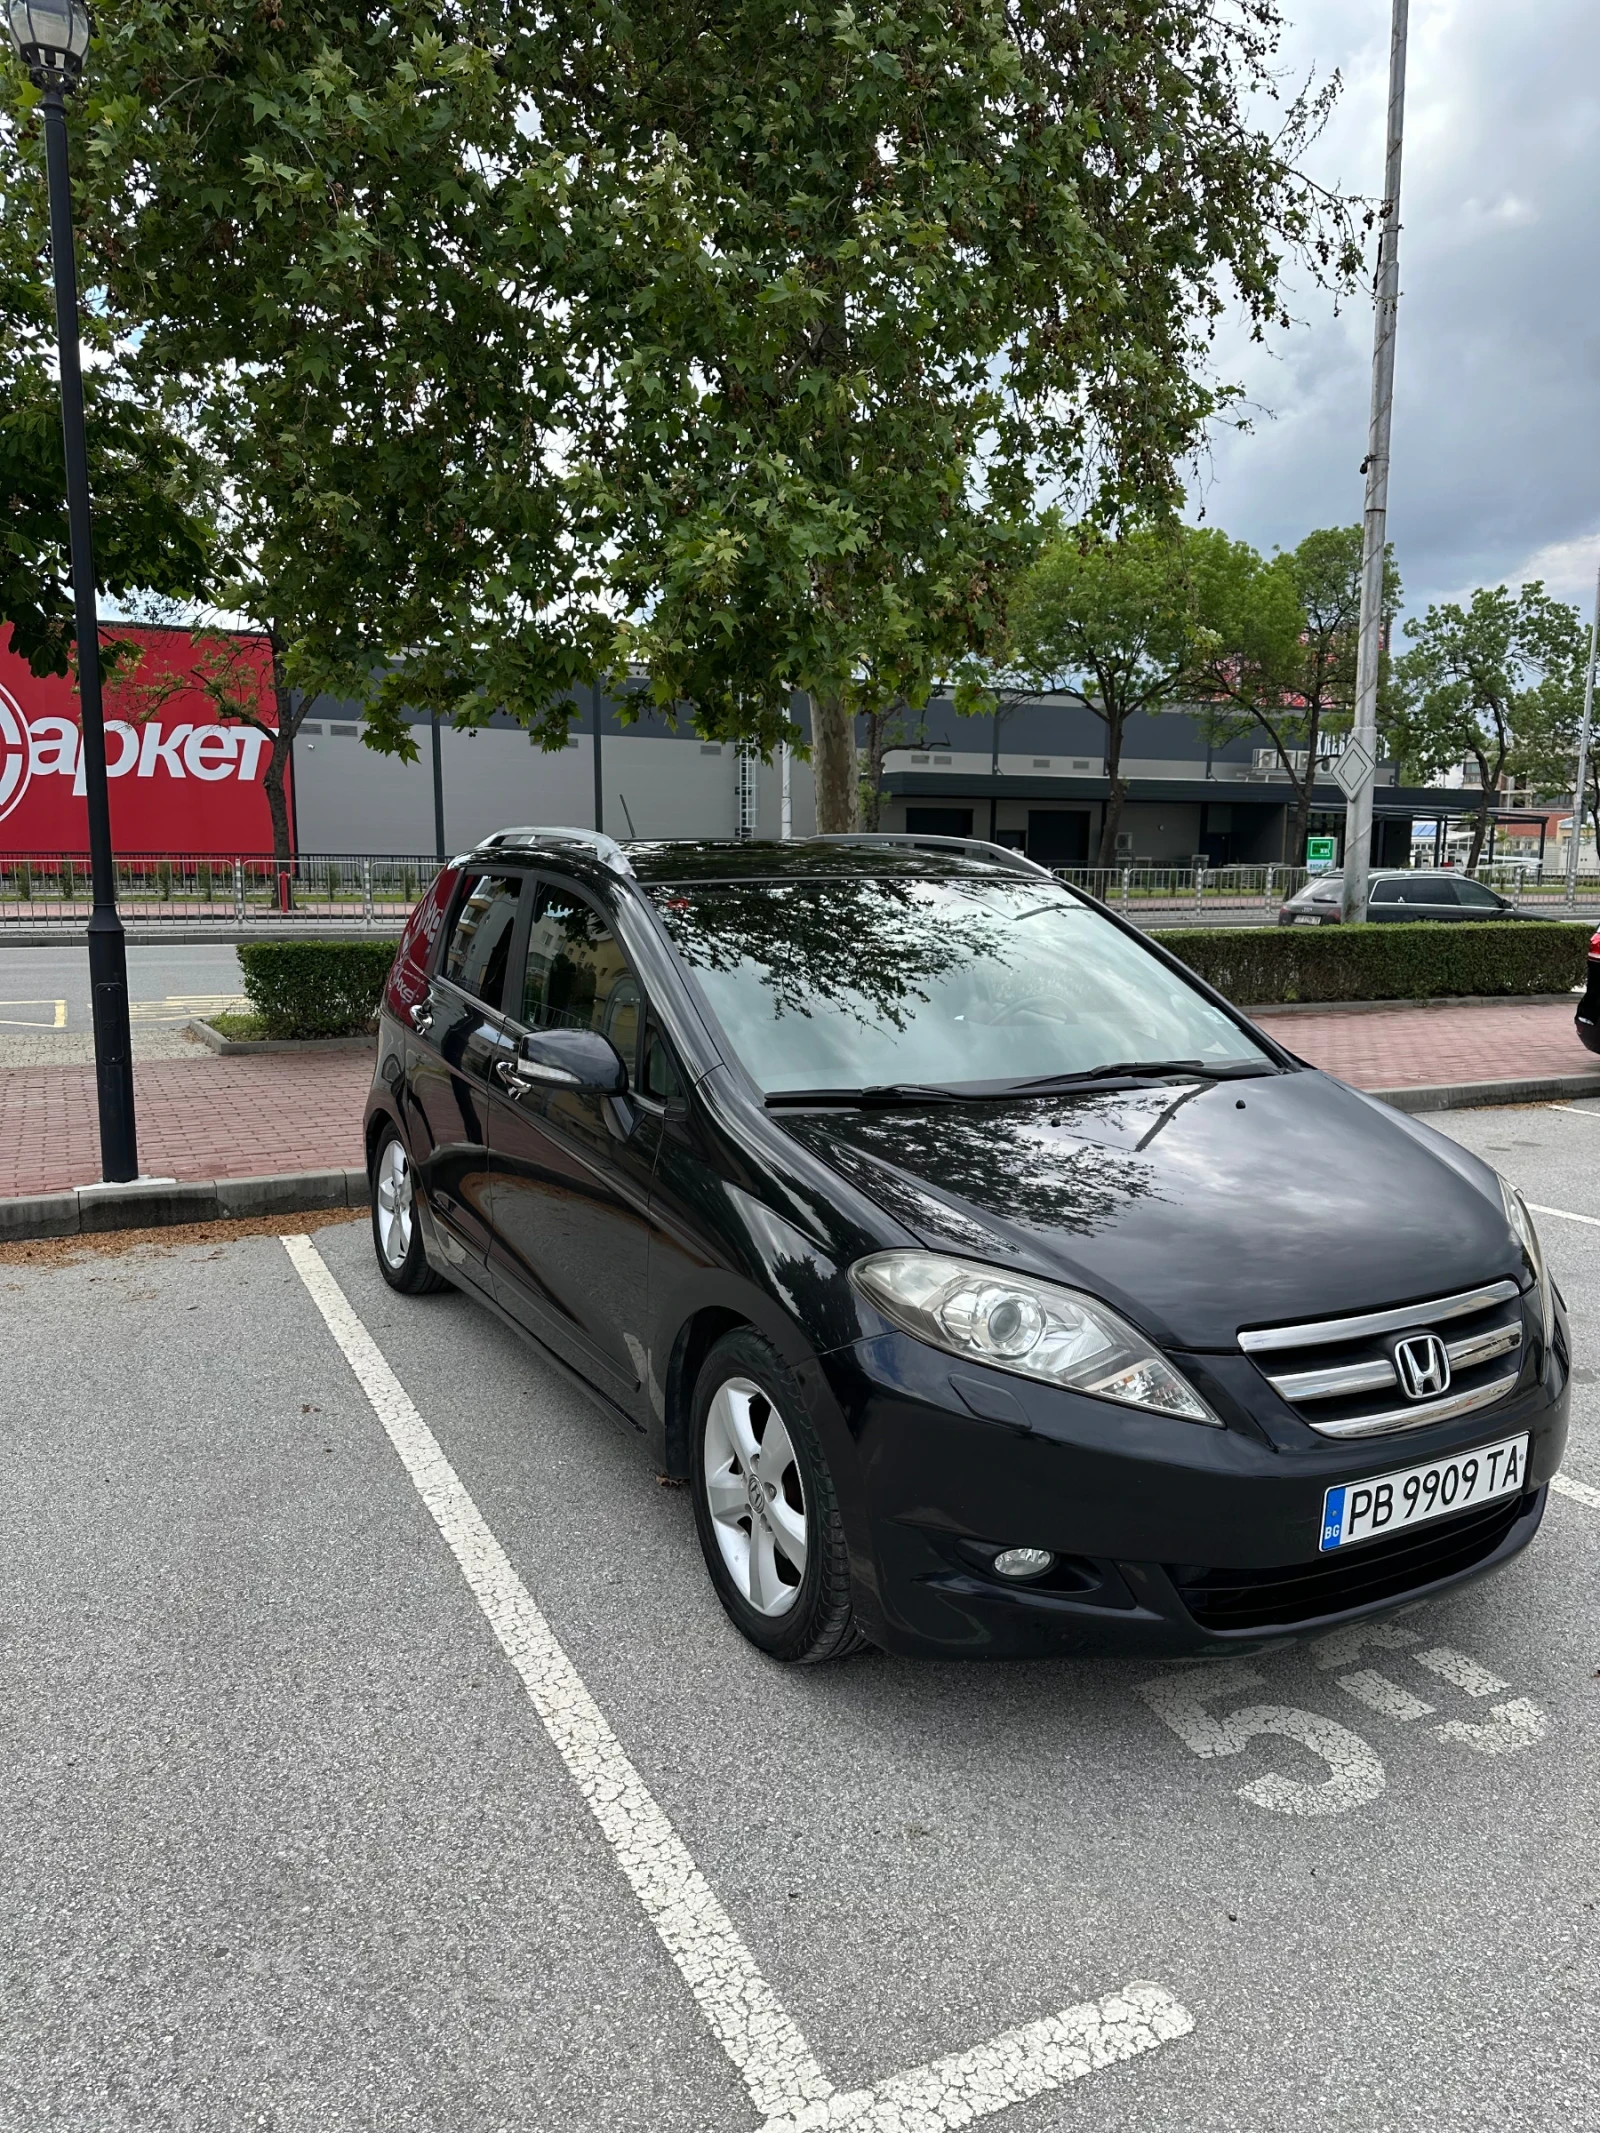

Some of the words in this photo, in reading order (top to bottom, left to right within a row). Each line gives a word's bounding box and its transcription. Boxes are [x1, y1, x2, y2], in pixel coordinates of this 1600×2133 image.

[1348, 1483, 1394, 1535] PB
[1403, 1458, 1479, 1519] 9909
[1487, 1445, 1518, 1492] TA
[1324, 1524, 1340, 1540] BG
